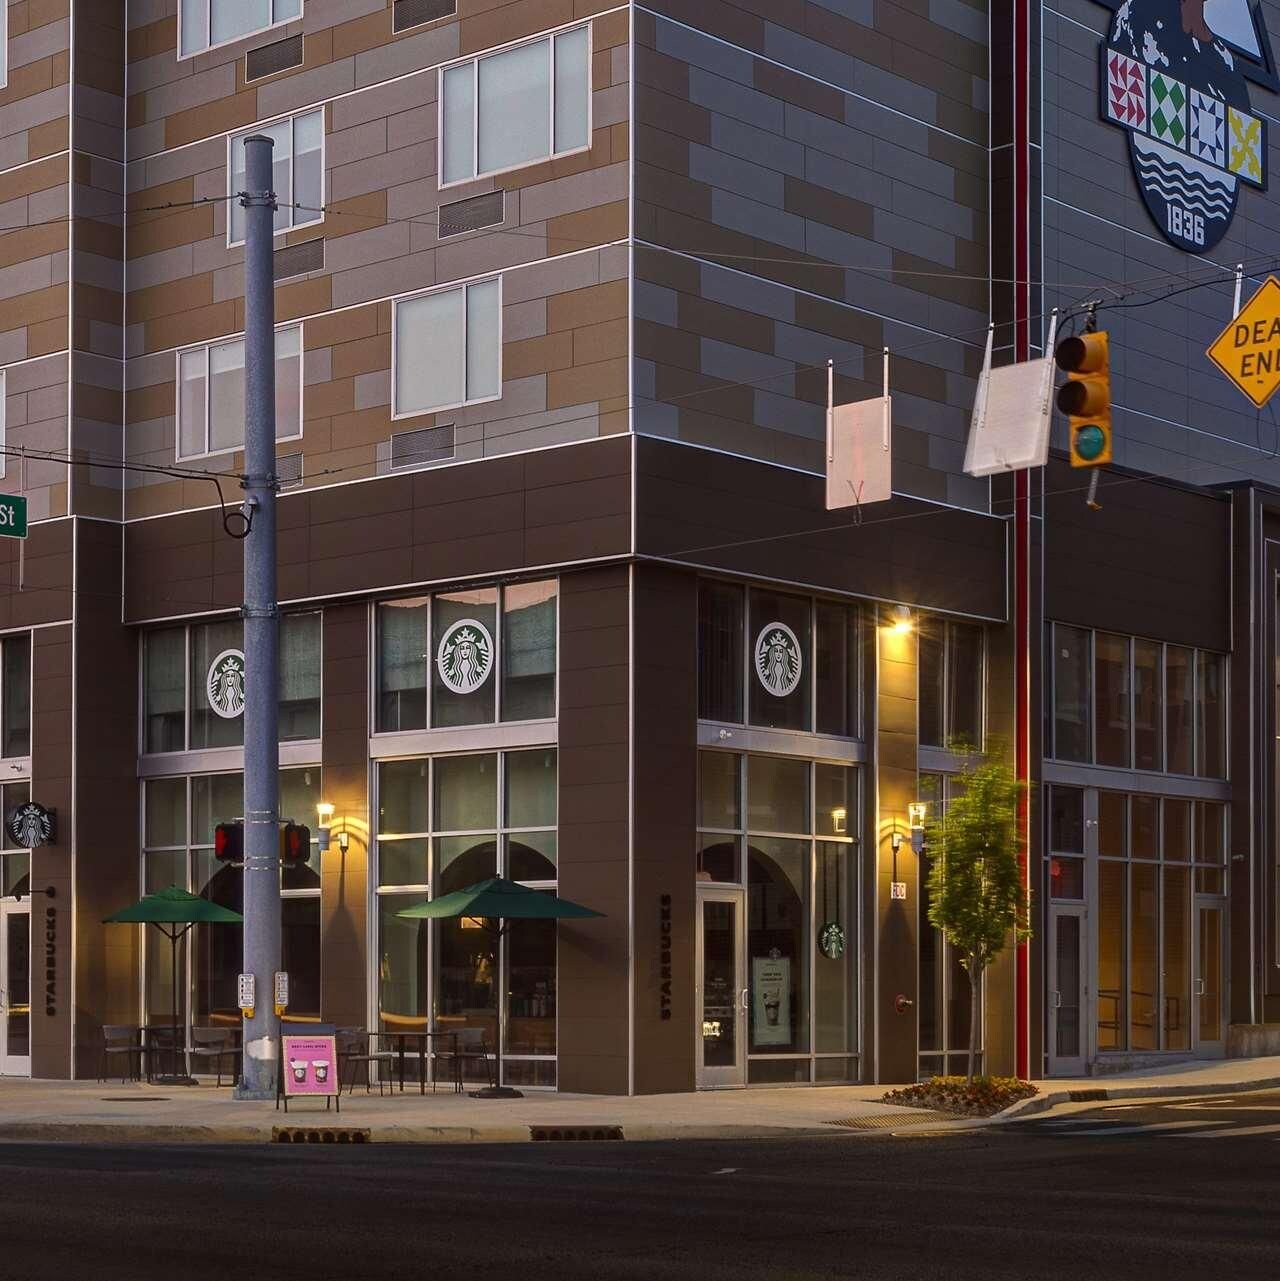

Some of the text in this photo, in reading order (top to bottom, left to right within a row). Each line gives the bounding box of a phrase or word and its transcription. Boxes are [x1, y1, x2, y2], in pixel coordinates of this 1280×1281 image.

[1167, 203, 1205, 246] 1836
[46, 907, 56, 1017] STARBUCKS
[660, 893, 672, 1020] STARBUCKS
